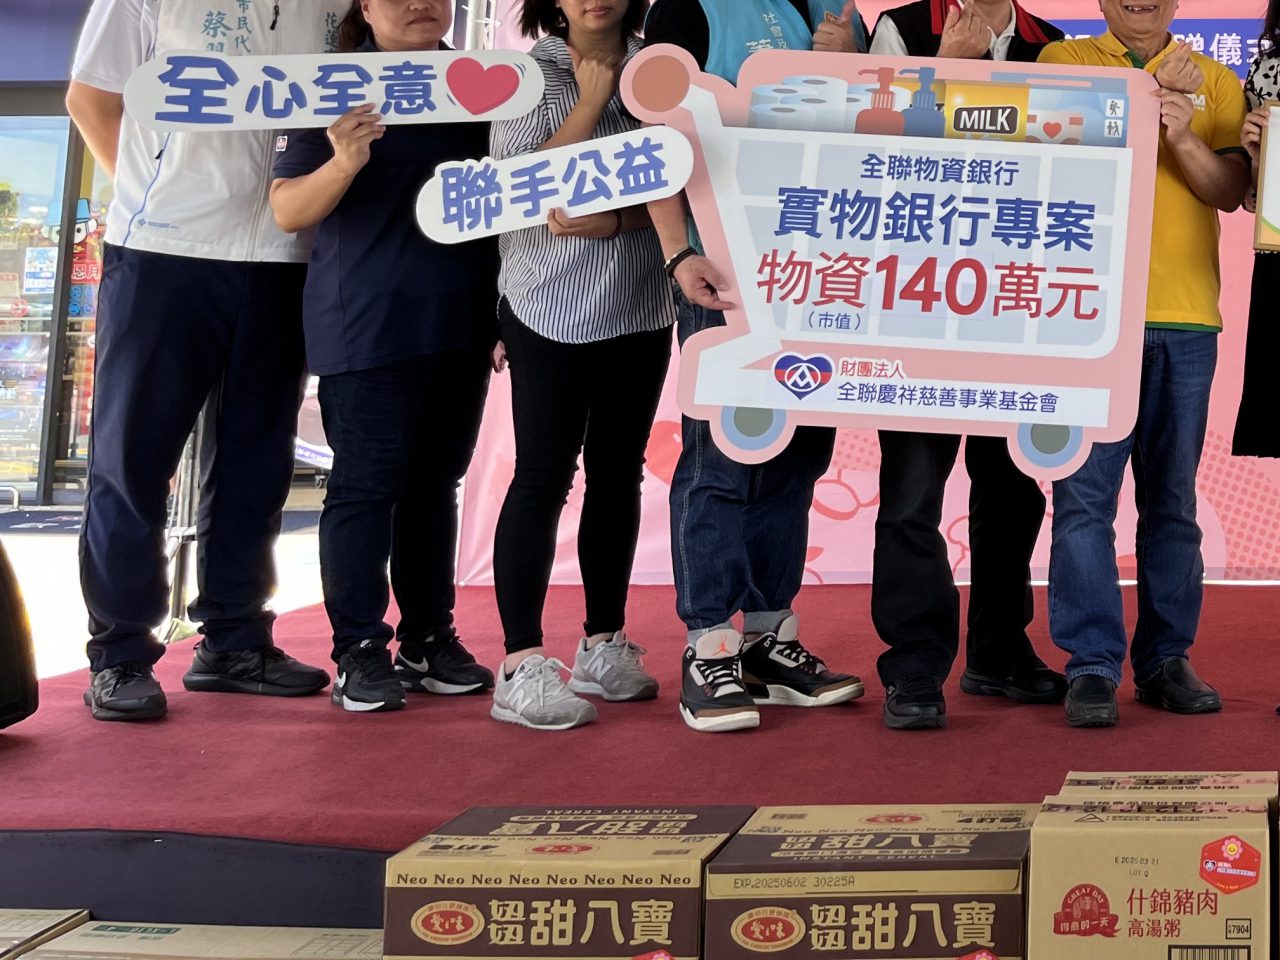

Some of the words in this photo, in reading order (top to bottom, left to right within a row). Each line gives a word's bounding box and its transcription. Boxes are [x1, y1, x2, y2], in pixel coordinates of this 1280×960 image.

[155, 55, 438, 124] 全心全意
[960, 110, 1009, 132] MILK
[441, 136, 669, 232] 聯手公益
[860, 153, 1019, 186] 全聯物資銀行
[773, 186, 1096, 252] 實物銀行專案
[756, 248, 1099, 321] 物資140萬元
[840, 360, 905, 380] 財團法人
[837, 382, 1059, 414] 全聯慶祥慈善事業基金會
[397, 873, 427, 885] Neo
[434, 873, 465, 885] Neo
[472, 873, 502, 885] Neo
[509, 873, 540, 885] Neo
[547, 873, 577, 885] Neo
[585, 873, 615, 885] Neo
[622, 873, 653, 885] Neo
[660, 873, 691, 885] Neo
[1126, 888, 1218, 916] 什錦豬肉
[1128, 918, 1181, 938] 高湯粥
